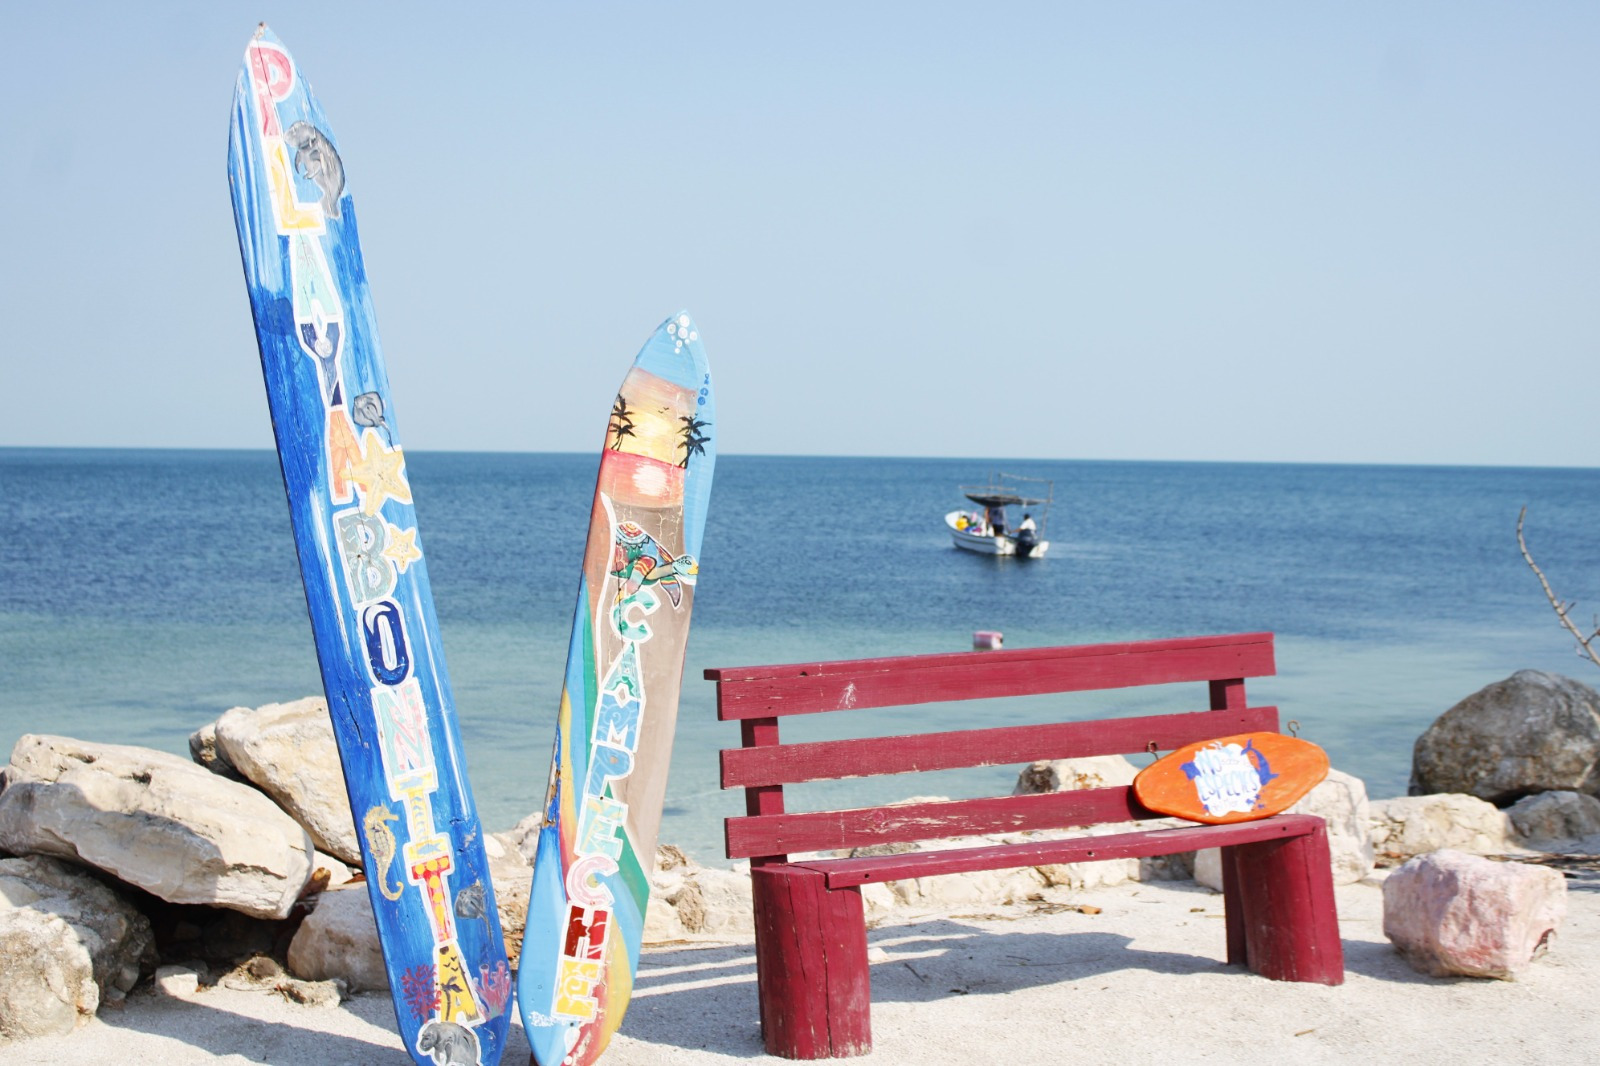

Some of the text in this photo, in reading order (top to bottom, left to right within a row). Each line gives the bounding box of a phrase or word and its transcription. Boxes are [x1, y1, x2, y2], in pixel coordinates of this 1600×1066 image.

[247, 40, 487, 1024] PLAYA BONITA
[551, 584, 662, 1023] CAMPECHE
